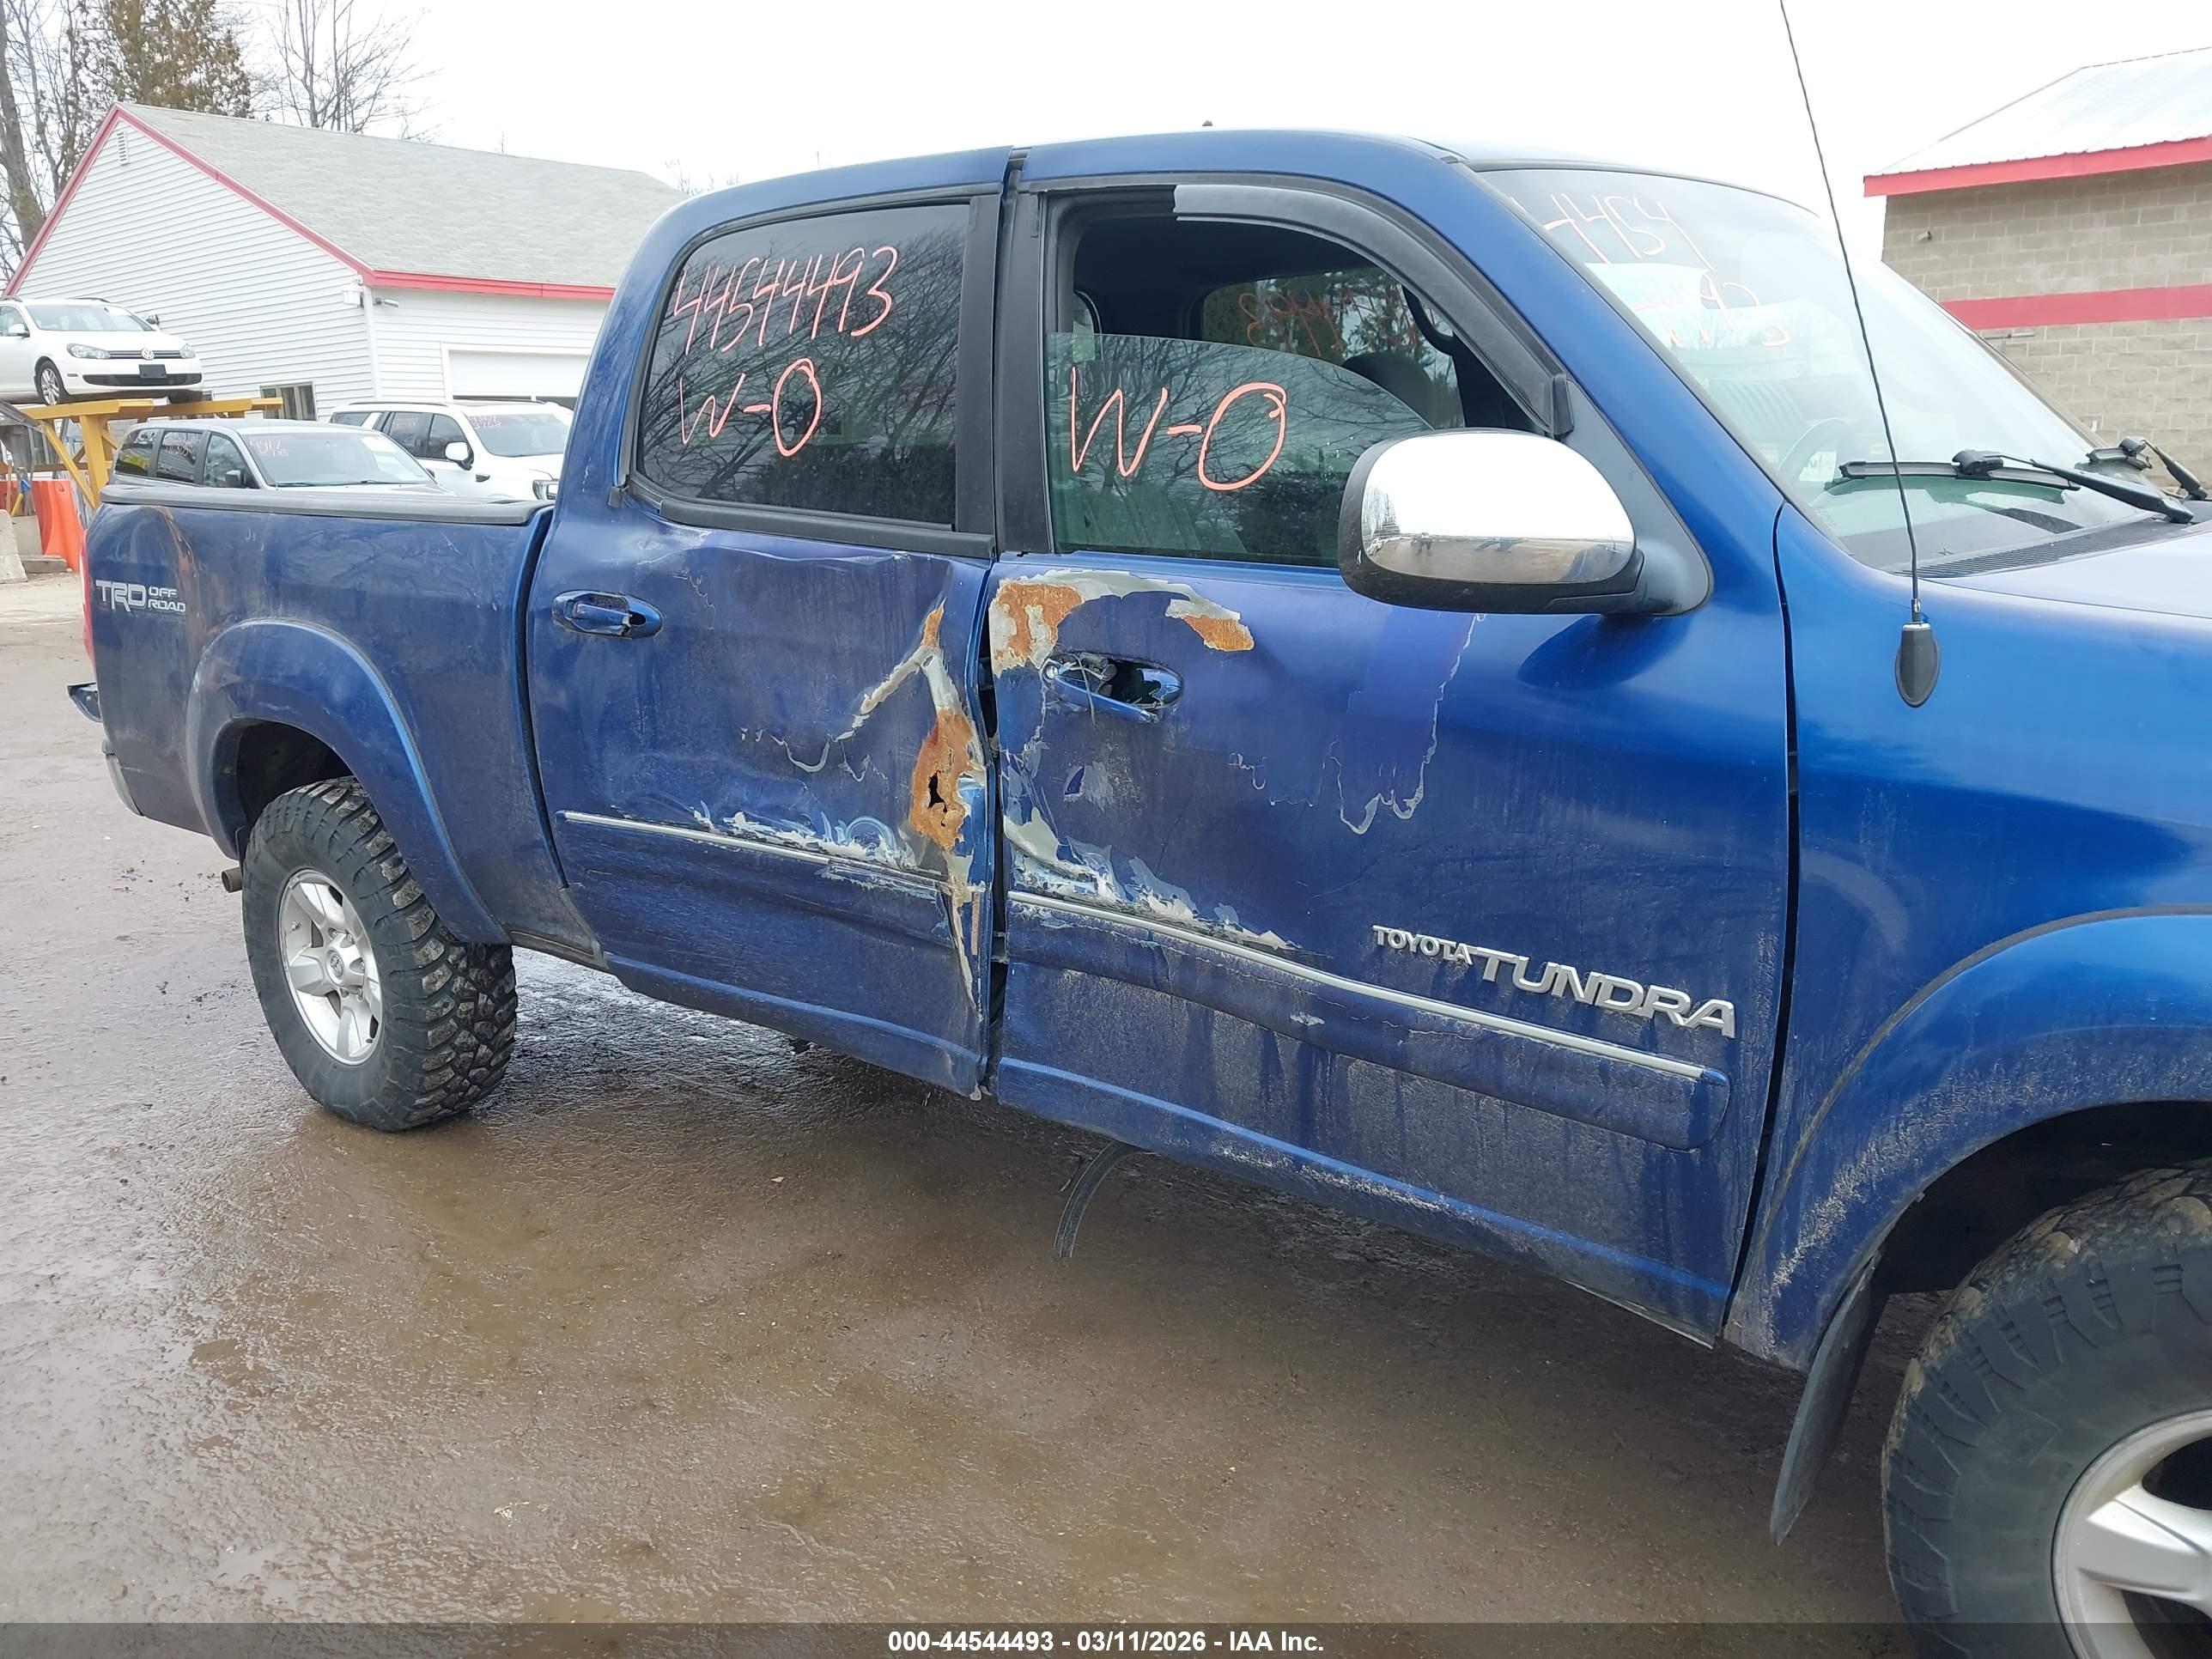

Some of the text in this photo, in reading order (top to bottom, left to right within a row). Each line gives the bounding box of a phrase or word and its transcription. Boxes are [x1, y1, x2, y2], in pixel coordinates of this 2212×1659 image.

[674, 246, 898, 356] 44544493
[95, 579, 148, 611] TRD
[148, 586, 178, 599] OFF
[148, 599, 185, 612] ROAD
[1372, 924, 1735, 1038] TOYOTA TUNDRA
